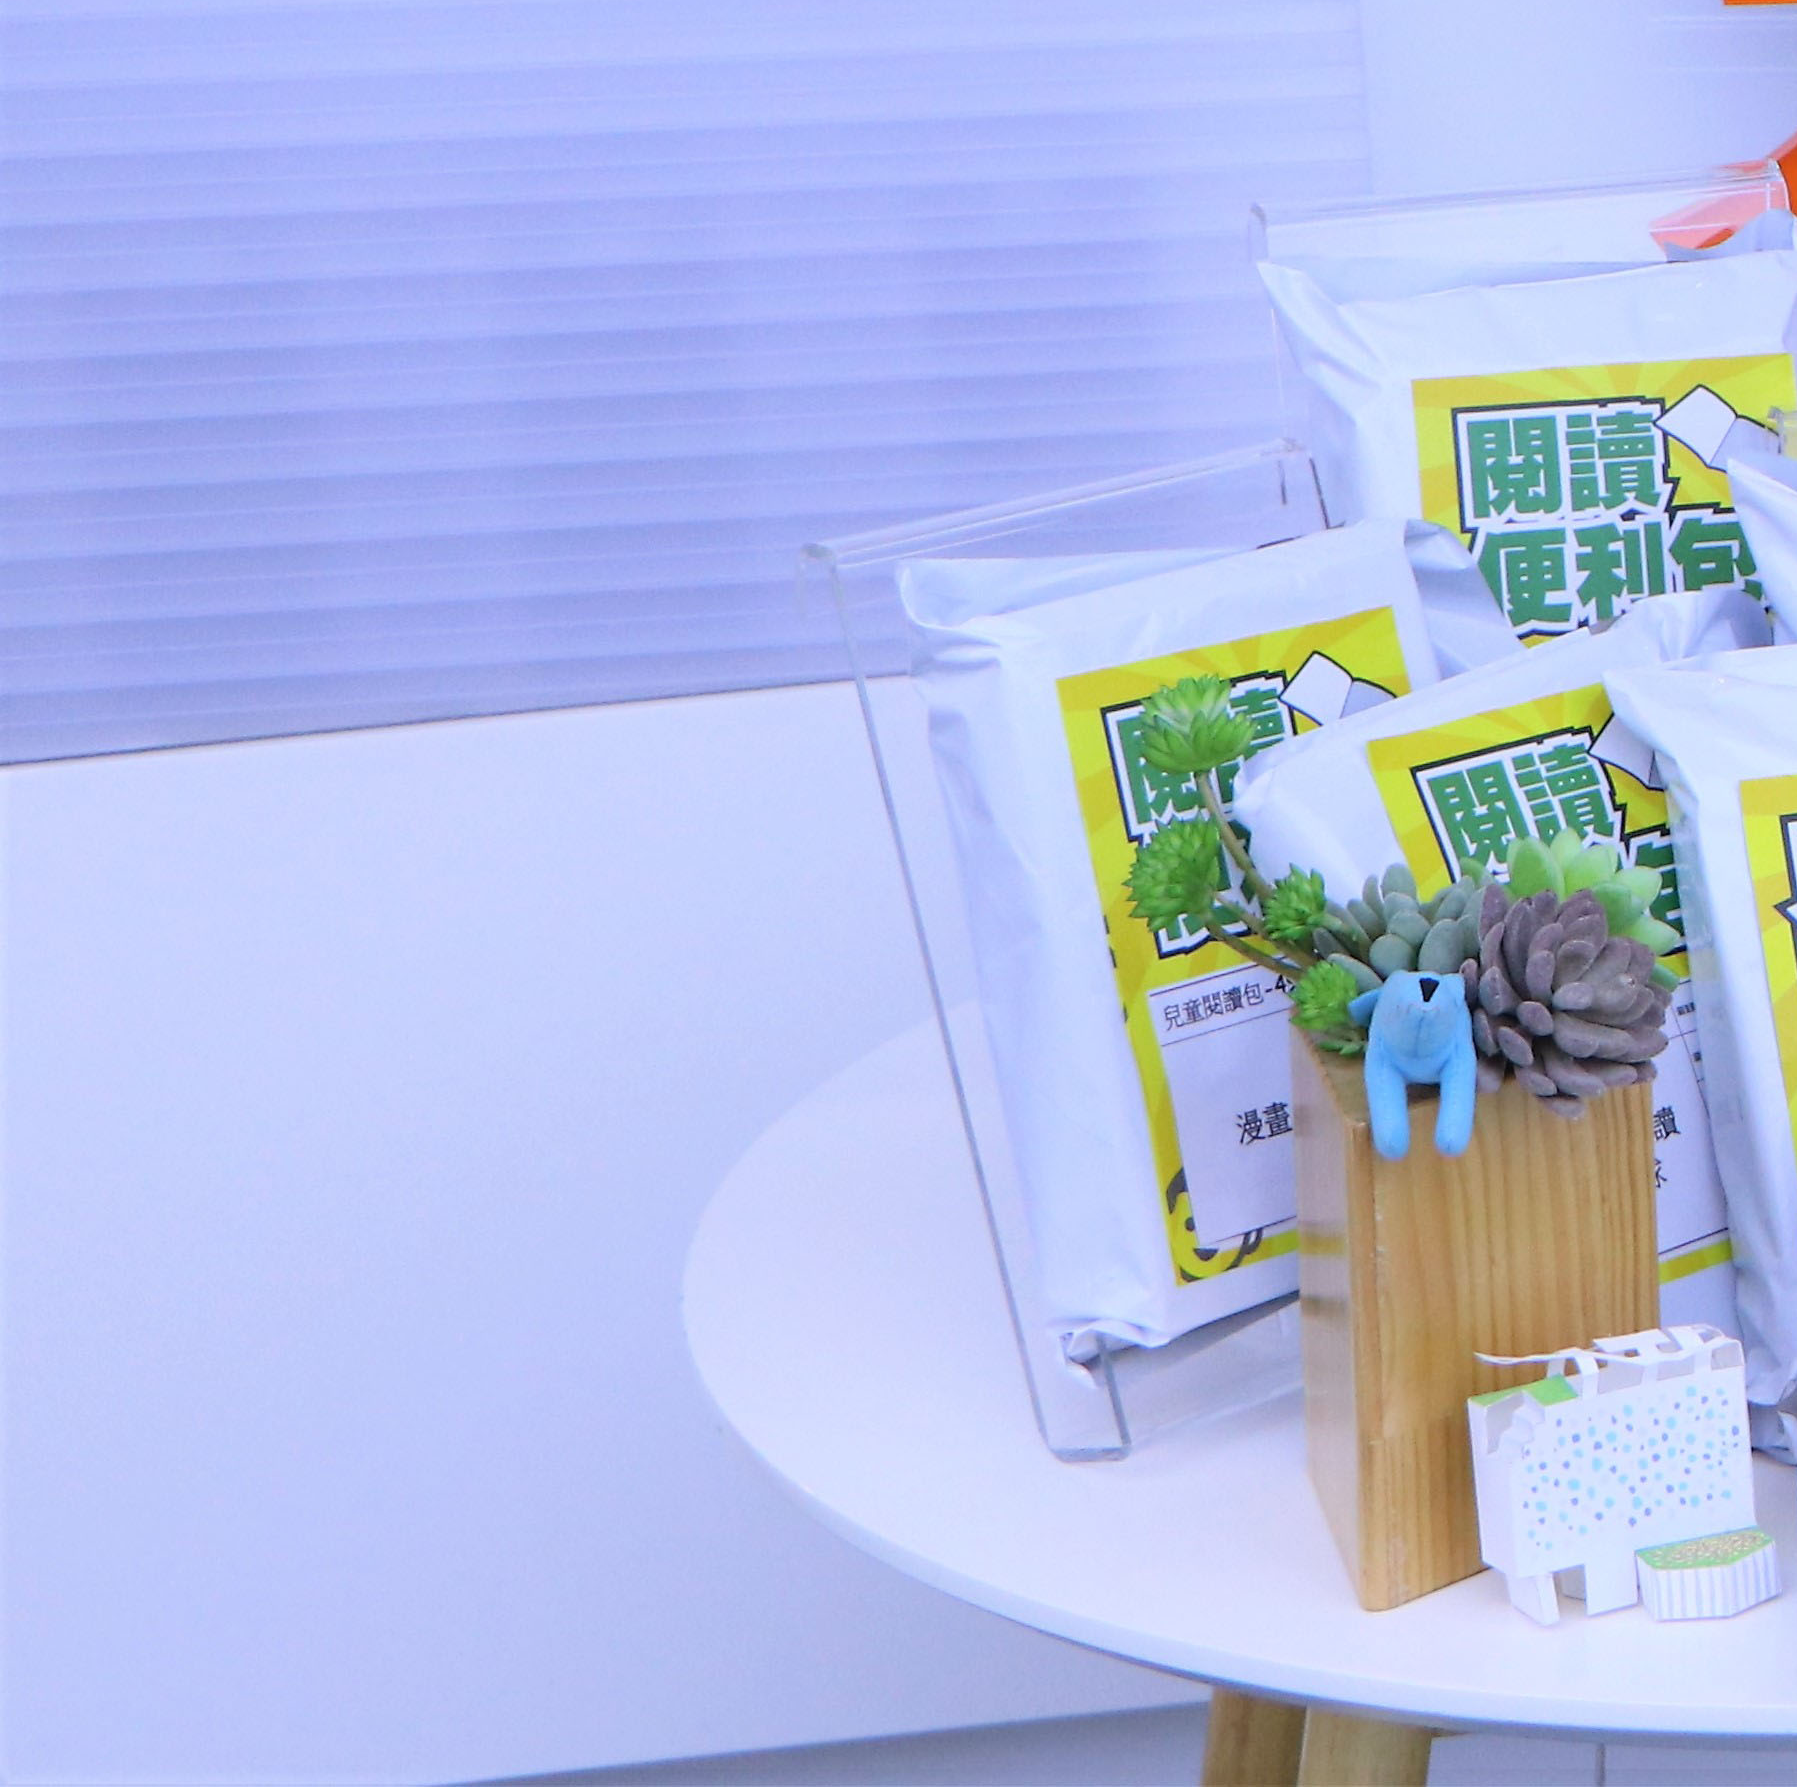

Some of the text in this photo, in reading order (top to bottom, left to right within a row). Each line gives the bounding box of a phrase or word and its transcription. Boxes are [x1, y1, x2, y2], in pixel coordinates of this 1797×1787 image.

[1466, 410, 1664, 519] 閱讀
[1428, 743, 1617, 871] 閱讀
[1163, 974, 1296, 1031] 兒童閱讀包-4
[1236, 1102, 1293, 1145] 漫畫
